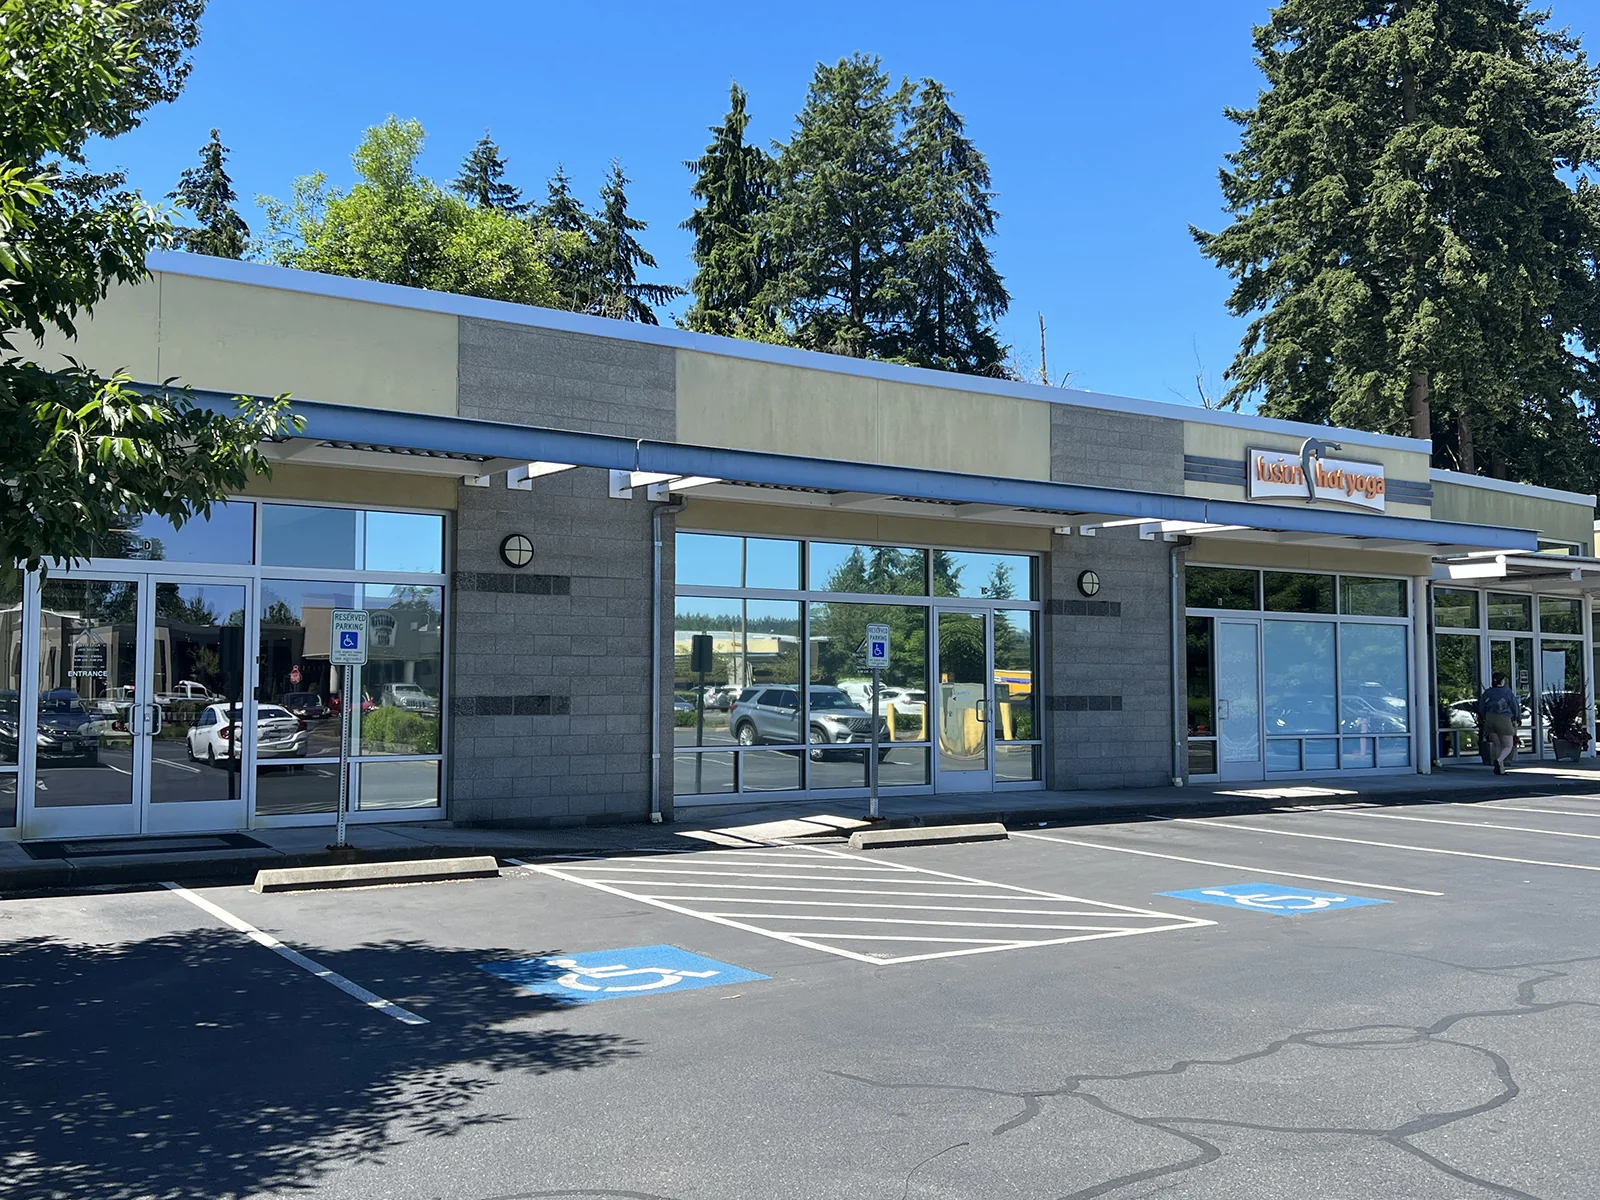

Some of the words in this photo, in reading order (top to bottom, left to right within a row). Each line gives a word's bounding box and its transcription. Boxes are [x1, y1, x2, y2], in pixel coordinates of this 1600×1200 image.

[1257, 455, 1303, 485] fusion
[1315, 463, 1345, 490] hot
[1345, 473, 1385, 499] yoga
[144, 540, 151, 550] D
[334, 613, 366, 621] RESERVED
[335, 622, 364, 631] PARKING
